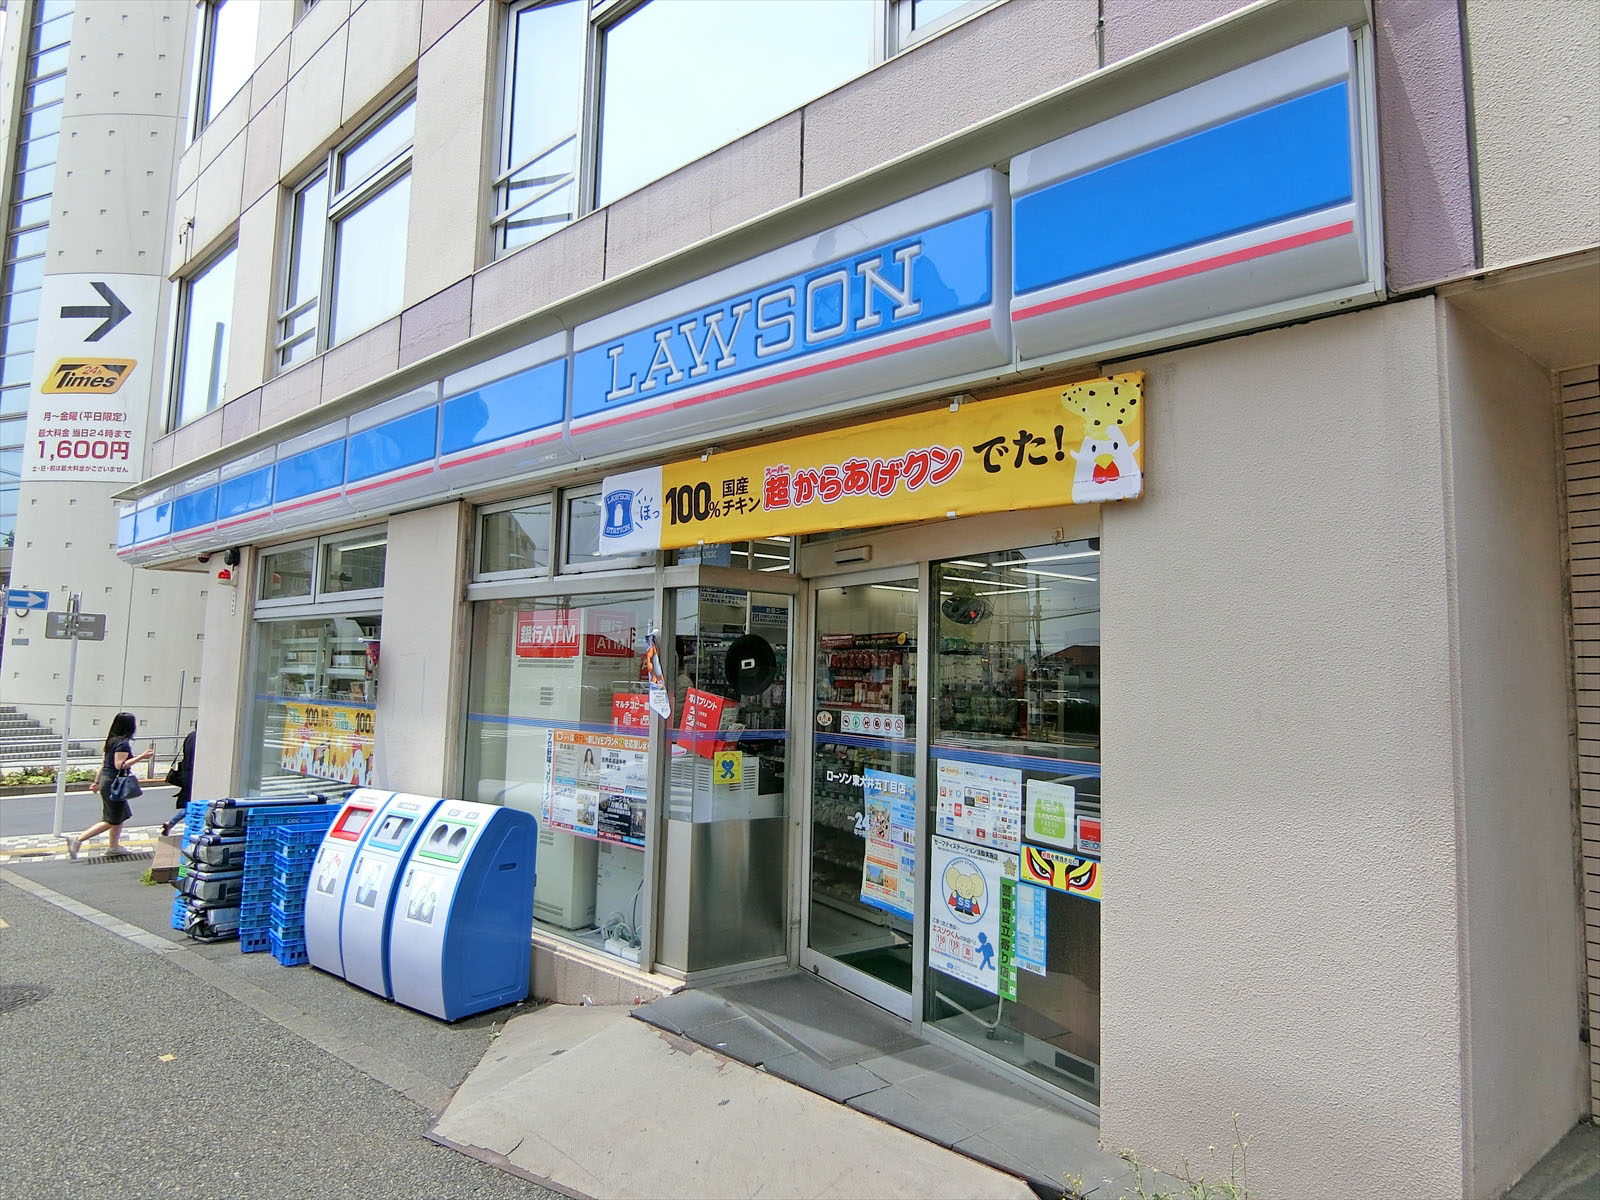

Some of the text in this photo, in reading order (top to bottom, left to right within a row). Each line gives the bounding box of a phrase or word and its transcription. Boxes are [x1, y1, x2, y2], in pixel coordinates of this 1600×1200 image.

[606, 241, 922, 401] LAWSON
[56, 370, 117, 389] Times
[38, 429, 70, 438] 最大料金
[38, 440, 130, 461] 1,600円
[973, 425, 1065, 473] でた!
[764, 446, 962, 510] 超からあげクン
[766, 463, 790, 476] スーパー
[722, 476, 749, 498] 国産
[640, 504, 660, 521] ほっ
[665, 481, 721, 525] 100%
[721, 495, 761, 517] チキン
[520, 624, 576, 644] 銀行ATM
[597, 636, 624, 650] ATM
[826, 770, 907, 796] ローソン東大井五丁目店
[958, 896, 971, 908] SS
